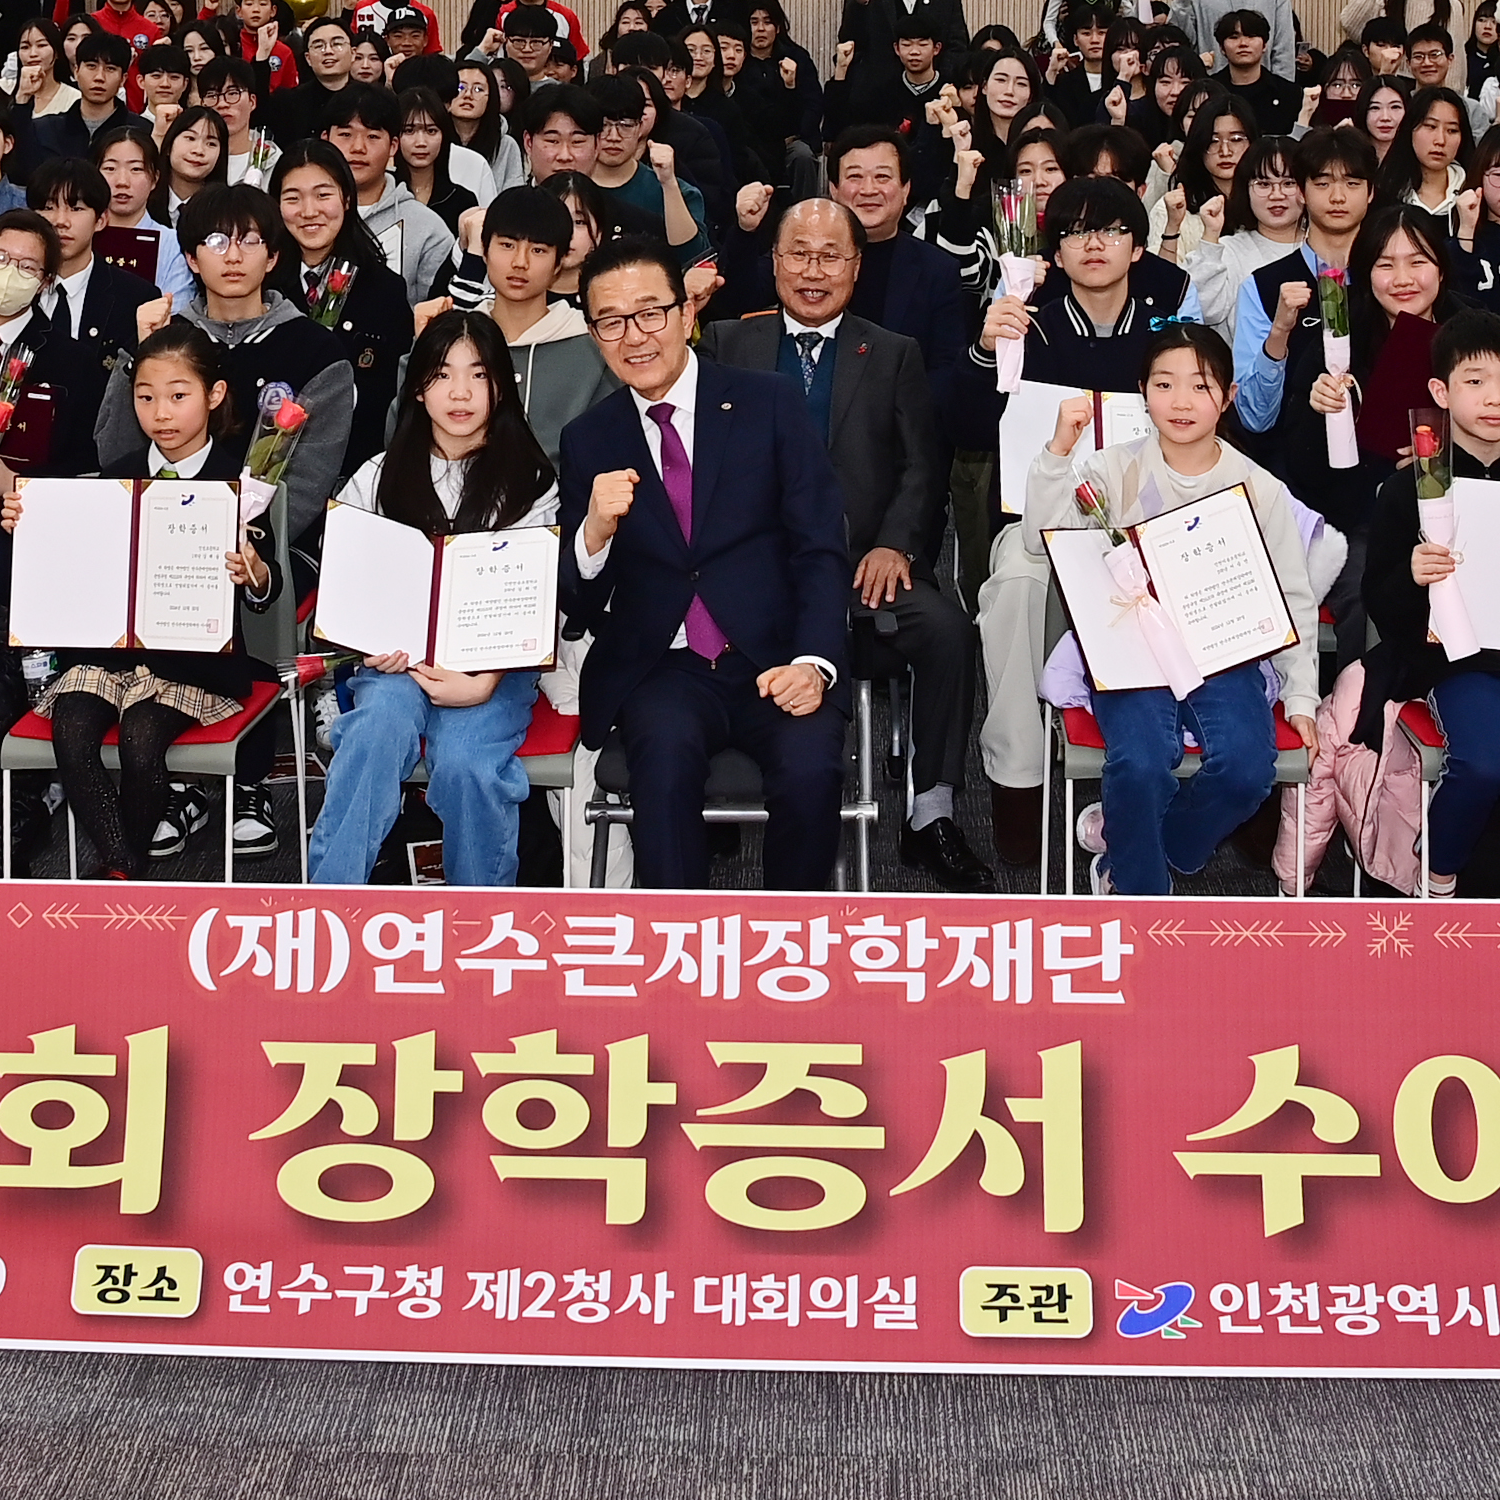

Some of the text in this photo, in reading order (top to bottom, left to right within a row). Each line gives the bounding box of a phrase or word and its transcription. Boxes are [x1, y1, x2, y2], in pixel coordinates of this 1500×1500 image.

[105, 255, 137, 268] 학증서
[167, 523, 208, 534] 장학증서
[1181, 537, 1227, 563] 장학증서
[187, 906, 1134, 1005] (재)연수큰재장학재단
[250, 1029, 1085, 1233] 장학증서
[92, 1263, 181, 1306] 장소
[223, 1260, 919, 1331] 연수구청 제2청사 대회의실
[980, 1282, 1074, 1325] 주관
